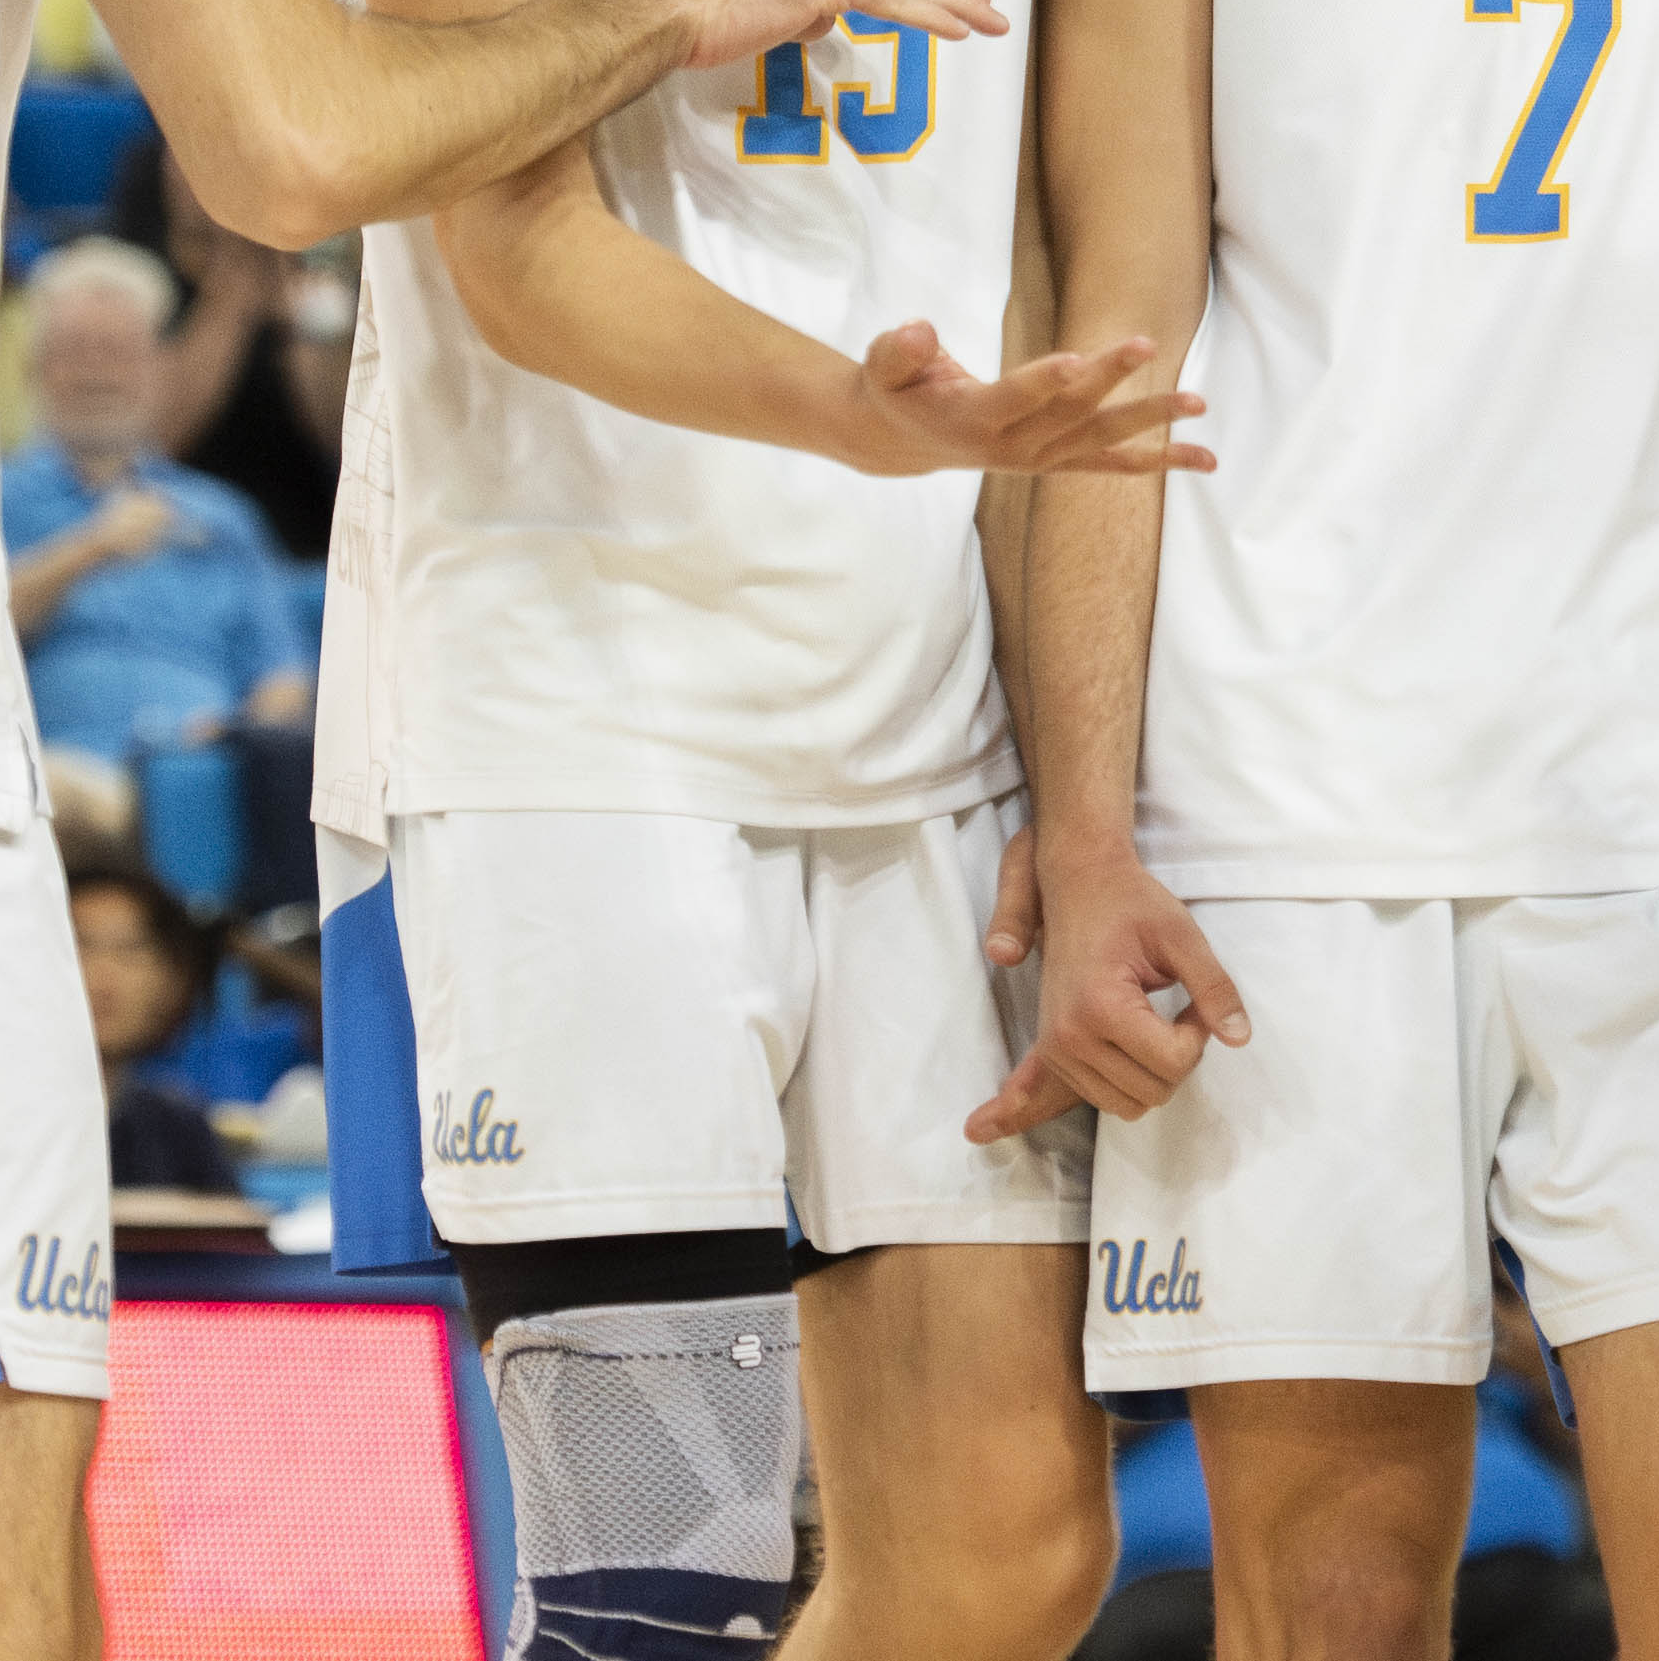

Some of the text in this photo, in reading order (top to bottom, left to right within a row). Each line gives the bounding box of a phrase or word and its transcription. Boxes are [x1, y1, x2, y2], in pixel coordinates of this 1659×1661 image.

[431, 1087, 526, 1168] Ucla
[14, 1232, 111, 1324] Ucla
[1097, 1237, 1204, 1317] Ucla
